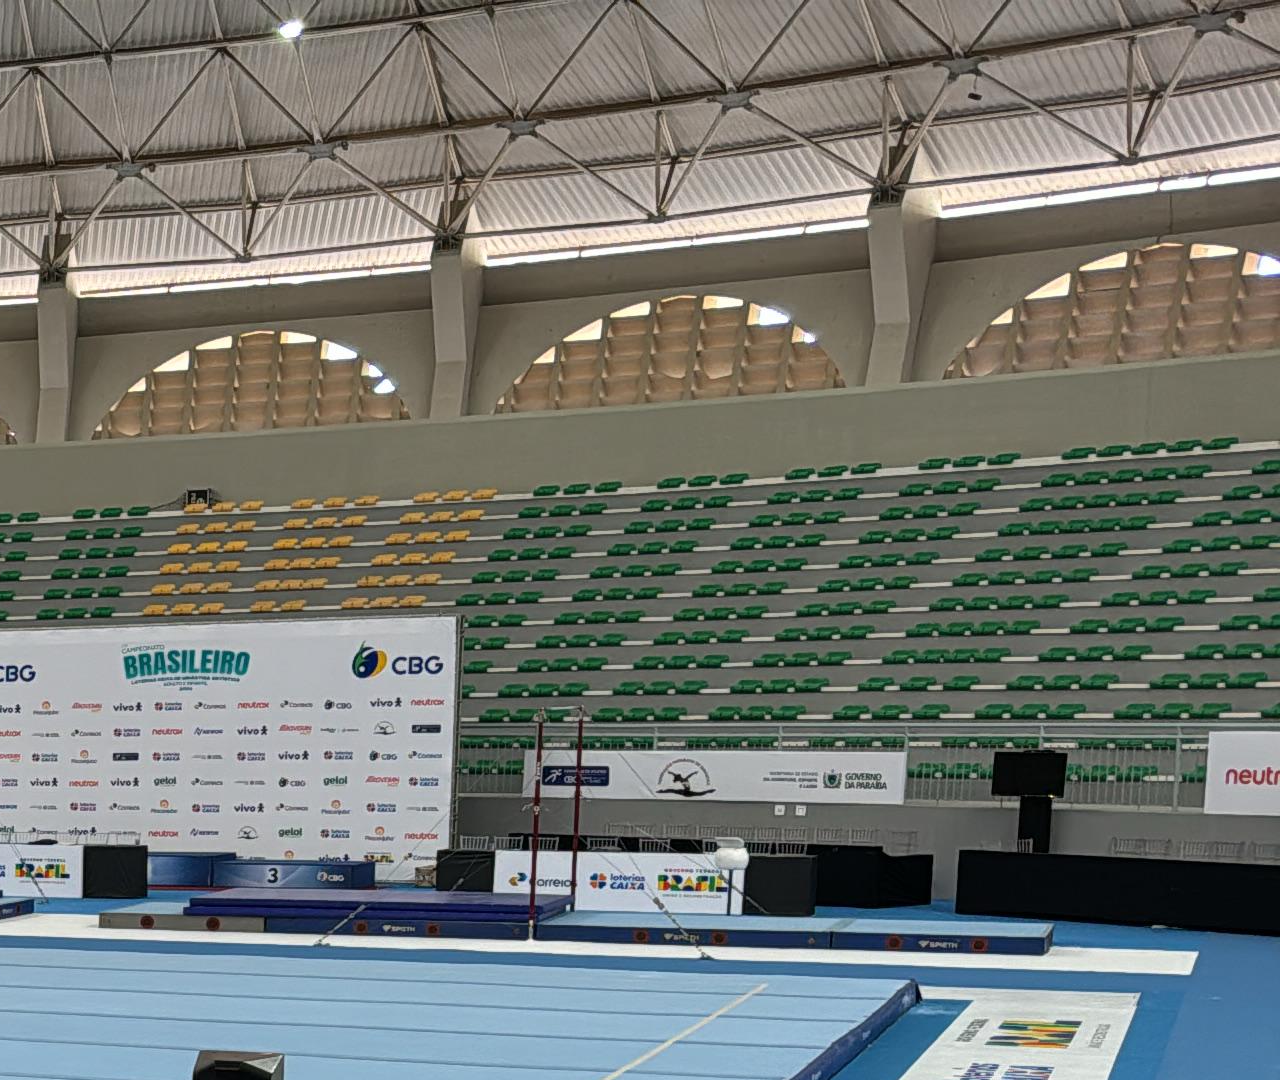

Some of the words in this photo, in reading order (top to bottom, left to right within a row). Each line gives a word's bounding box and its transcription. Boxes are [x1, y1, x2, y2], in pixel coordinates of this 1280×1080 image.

[123, 650, 251, 680] BRASILEIRO
[391, 655, 444, 675] CBG
[113, 702, 135, 713] vivo
[237, 701, 270, 710] neutrox
[370, 698, 393, 708] vivo
[410, 698, 446, 708] neutrox
[152, 728, 184, 737] neutrox
[237, 725, 259, 737] vivo
[278, 750, 301, 761] vivo
[323, 776, 348, 787] gelol
[845, 773, 882, 781] GOVERNO
[1225, 766, 1280, 786] neutr
[30, 778, 51, 788] vivo
[69, 780, 100, 789] neutrox
[110, 778, 132, 788] vivo
[153, 776, 178, 788] gelol
[856, 781, 888, 792] PARAÍBA
[234, 803, 257, 814] vivo
[148, 830, 179, 839] neutrox
[278, 827, 305, 839] gelol
[15, 863, 70, 879] BRASIL
[267, 867, 279, 884] 3
[609, 873, 645, 882] loterias
[657, 874, 728, 892] BRASIL
[529, 879, 577, 888] orreio
[609, 882, 645, 891] CAIXA
